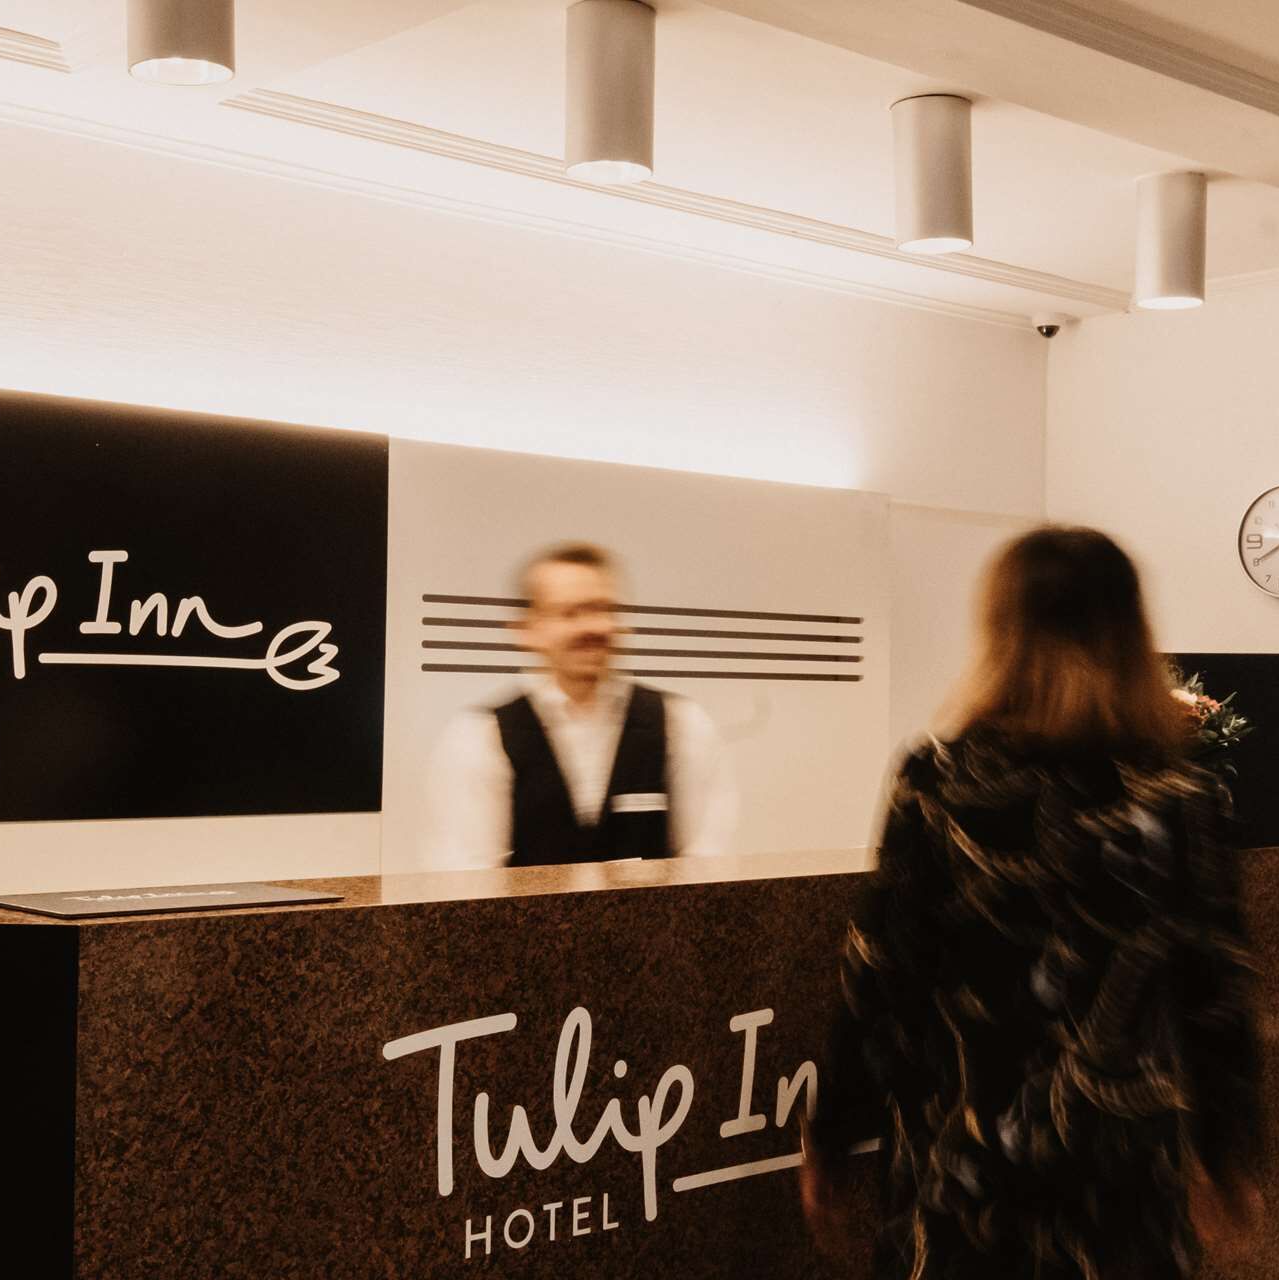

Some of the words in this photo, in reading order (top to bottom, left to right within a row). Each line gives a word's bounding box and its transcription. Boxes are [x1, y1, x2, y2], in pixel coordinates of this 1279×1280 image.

[1246, 533, 1263, 549] 9
[80, 550, 264, 639] Inn
[382, 1006, 694, 1221] Tulip
[720, 1008, 818, 1138] In
[465, 1193, 619, 1259] HOTEL
